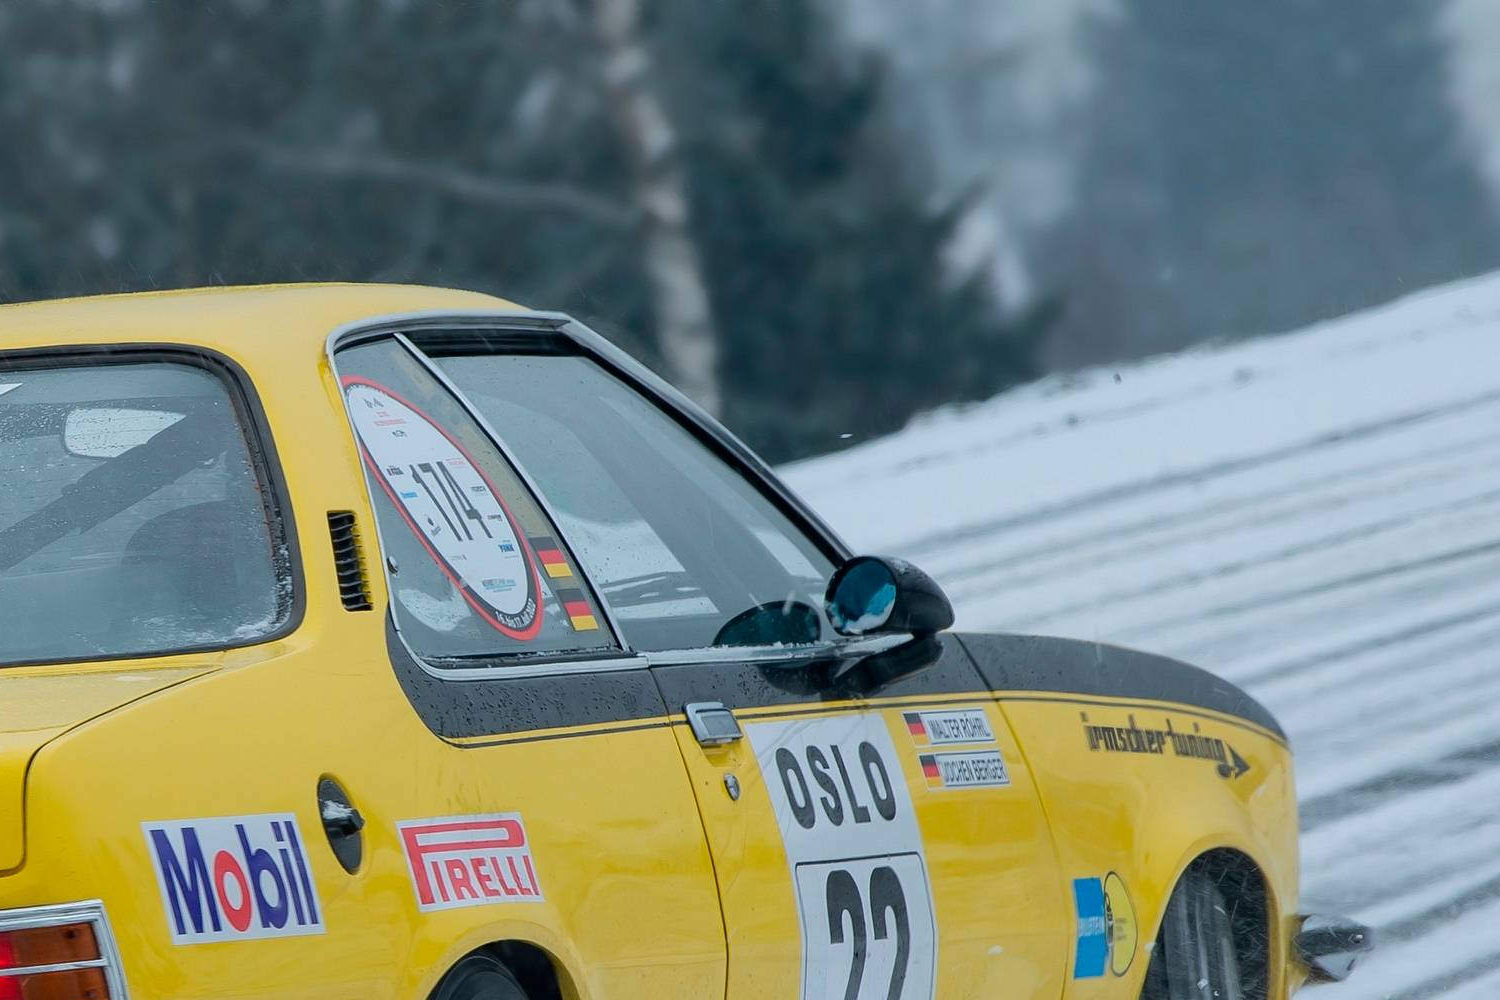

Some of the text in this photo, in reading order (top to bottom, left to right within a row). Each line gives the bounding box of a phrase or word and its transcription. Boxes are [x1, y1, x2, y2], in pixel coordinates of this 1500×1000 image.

[409, 461, 493, 541] 174
[928, 719, 964, 739] WALTER
[775, 740, 897, 829] OSLO
[148, 820, 320, 935] Mobil
[400, 819, 541, 905] PIRELLI
